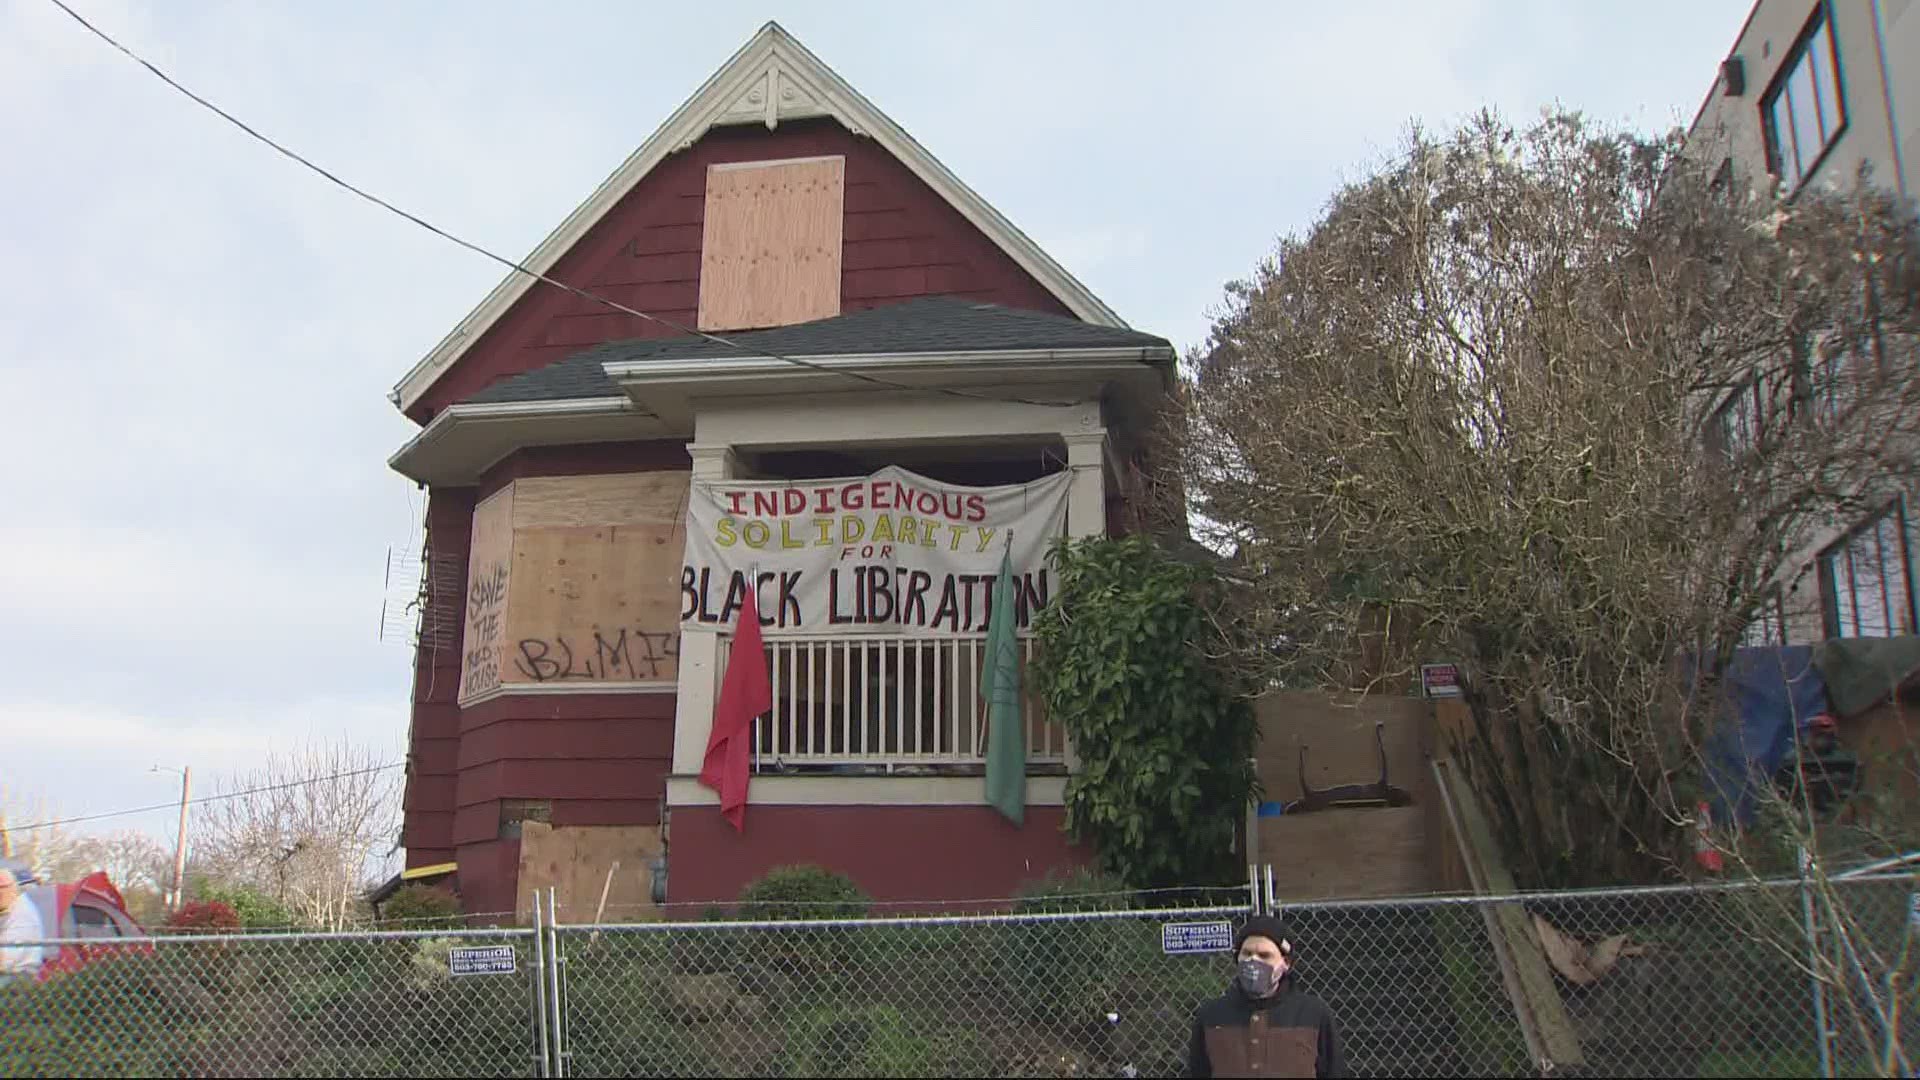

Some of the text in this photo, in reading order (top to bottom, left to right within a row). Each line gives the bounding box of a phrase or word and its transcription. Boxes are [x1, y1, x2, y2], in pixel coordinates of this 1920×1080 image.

[725, 482, 986, 522] INDIGENOUS
[715, 513, 995, 552] SOLIDARITY
[840, 545, 892, 560] FOR
[681, 565, 803, 628] BLACK
[474, 611, 500, 650] THE
[1166, 924, 1228, 934] SUPERIOR
[453, 948, 511, 958] SUPERIOR
